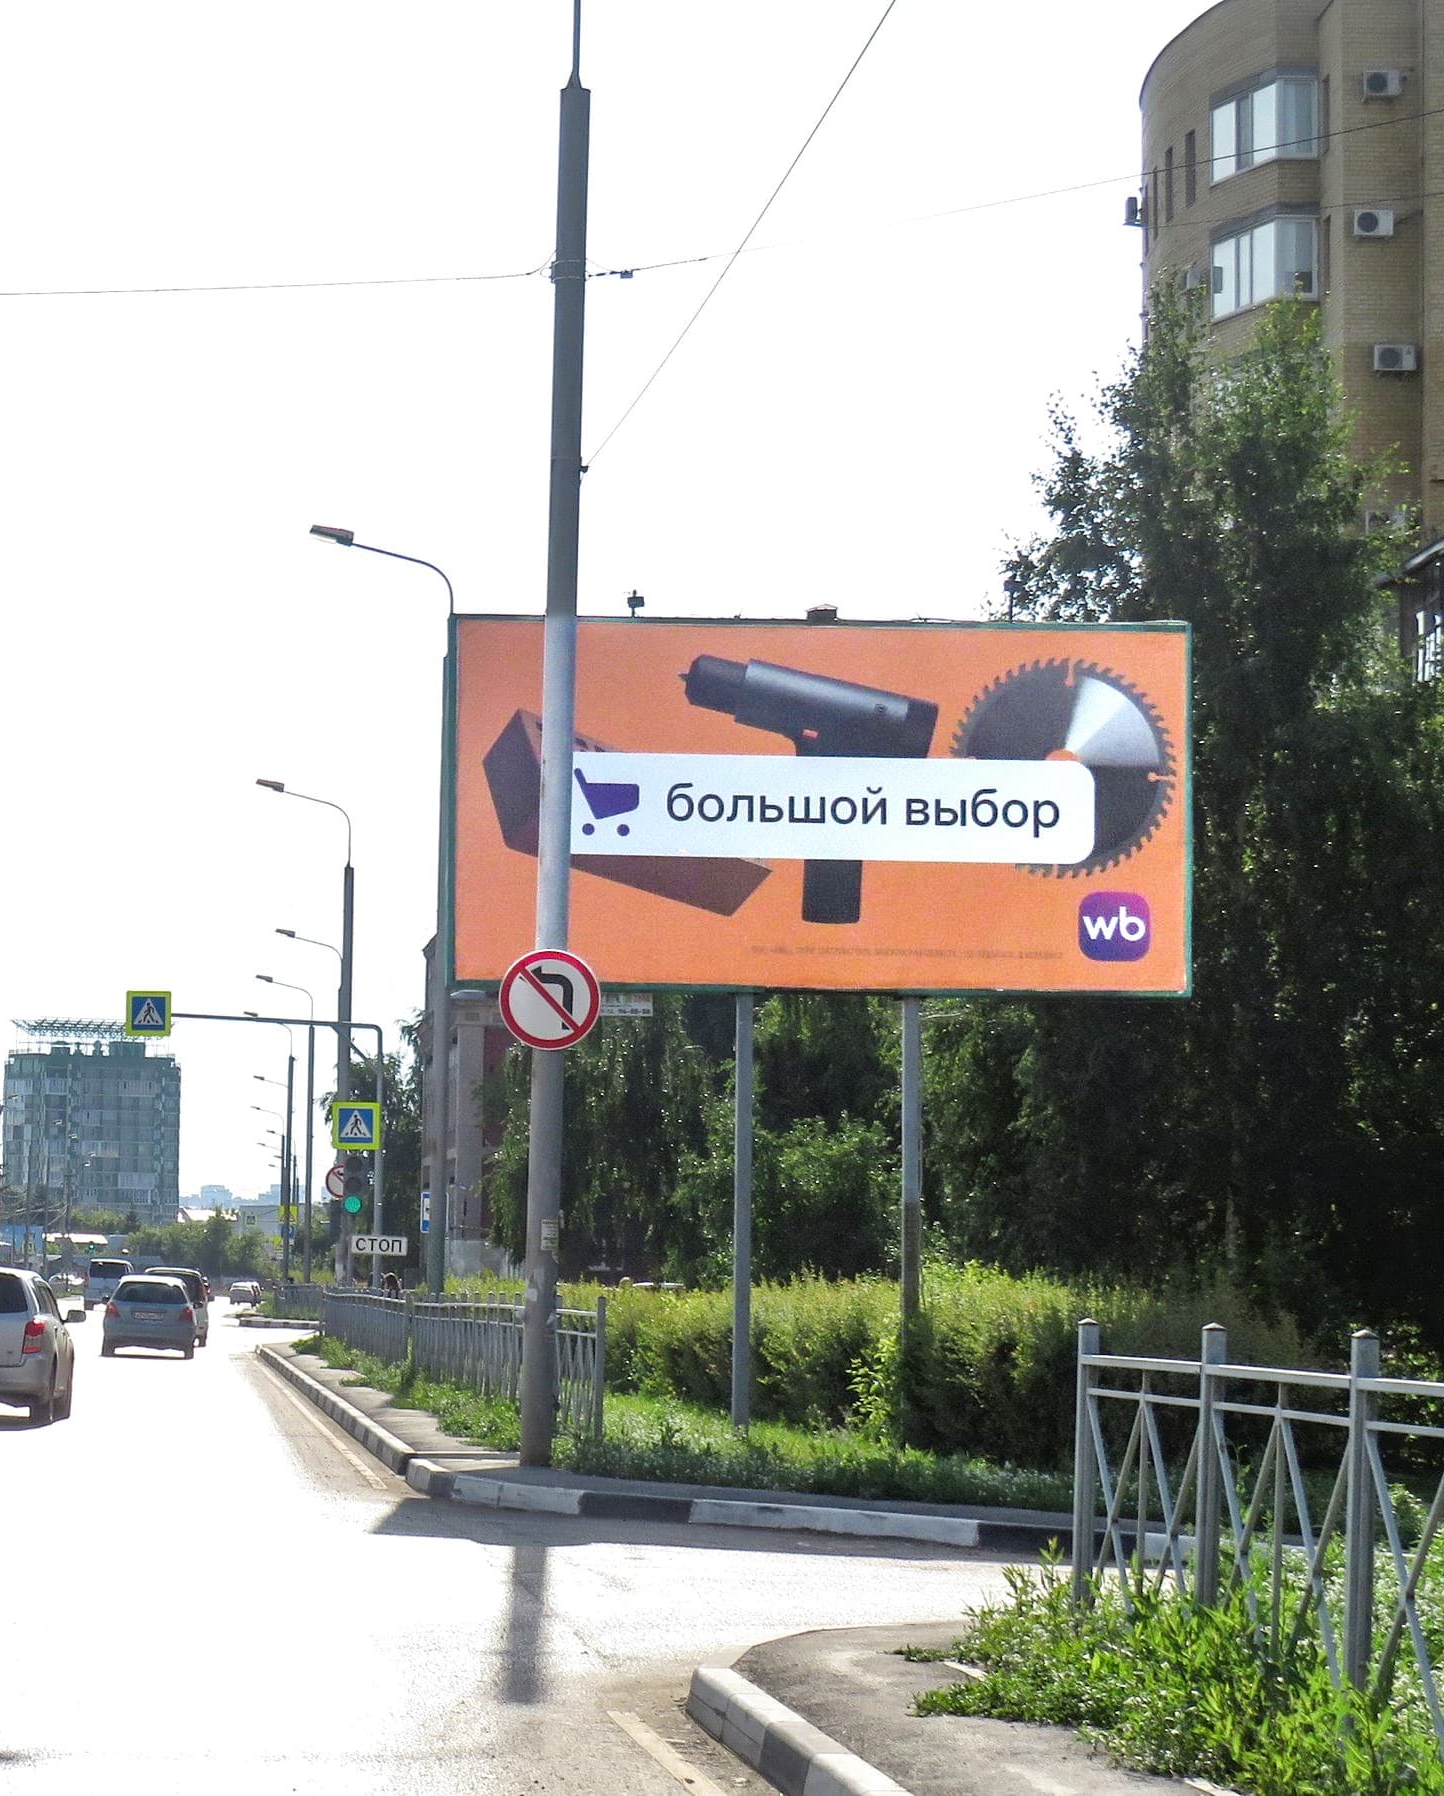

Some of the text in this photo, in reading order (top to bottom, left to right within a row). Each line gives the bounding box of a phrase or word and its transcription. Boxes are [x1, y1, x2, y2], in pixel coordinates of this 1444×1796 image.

[666, 783, 1061, 838] большой выбор
[1083, 906, 1147, 942] wb
[355, 1237, 403, 1253] СТОП
